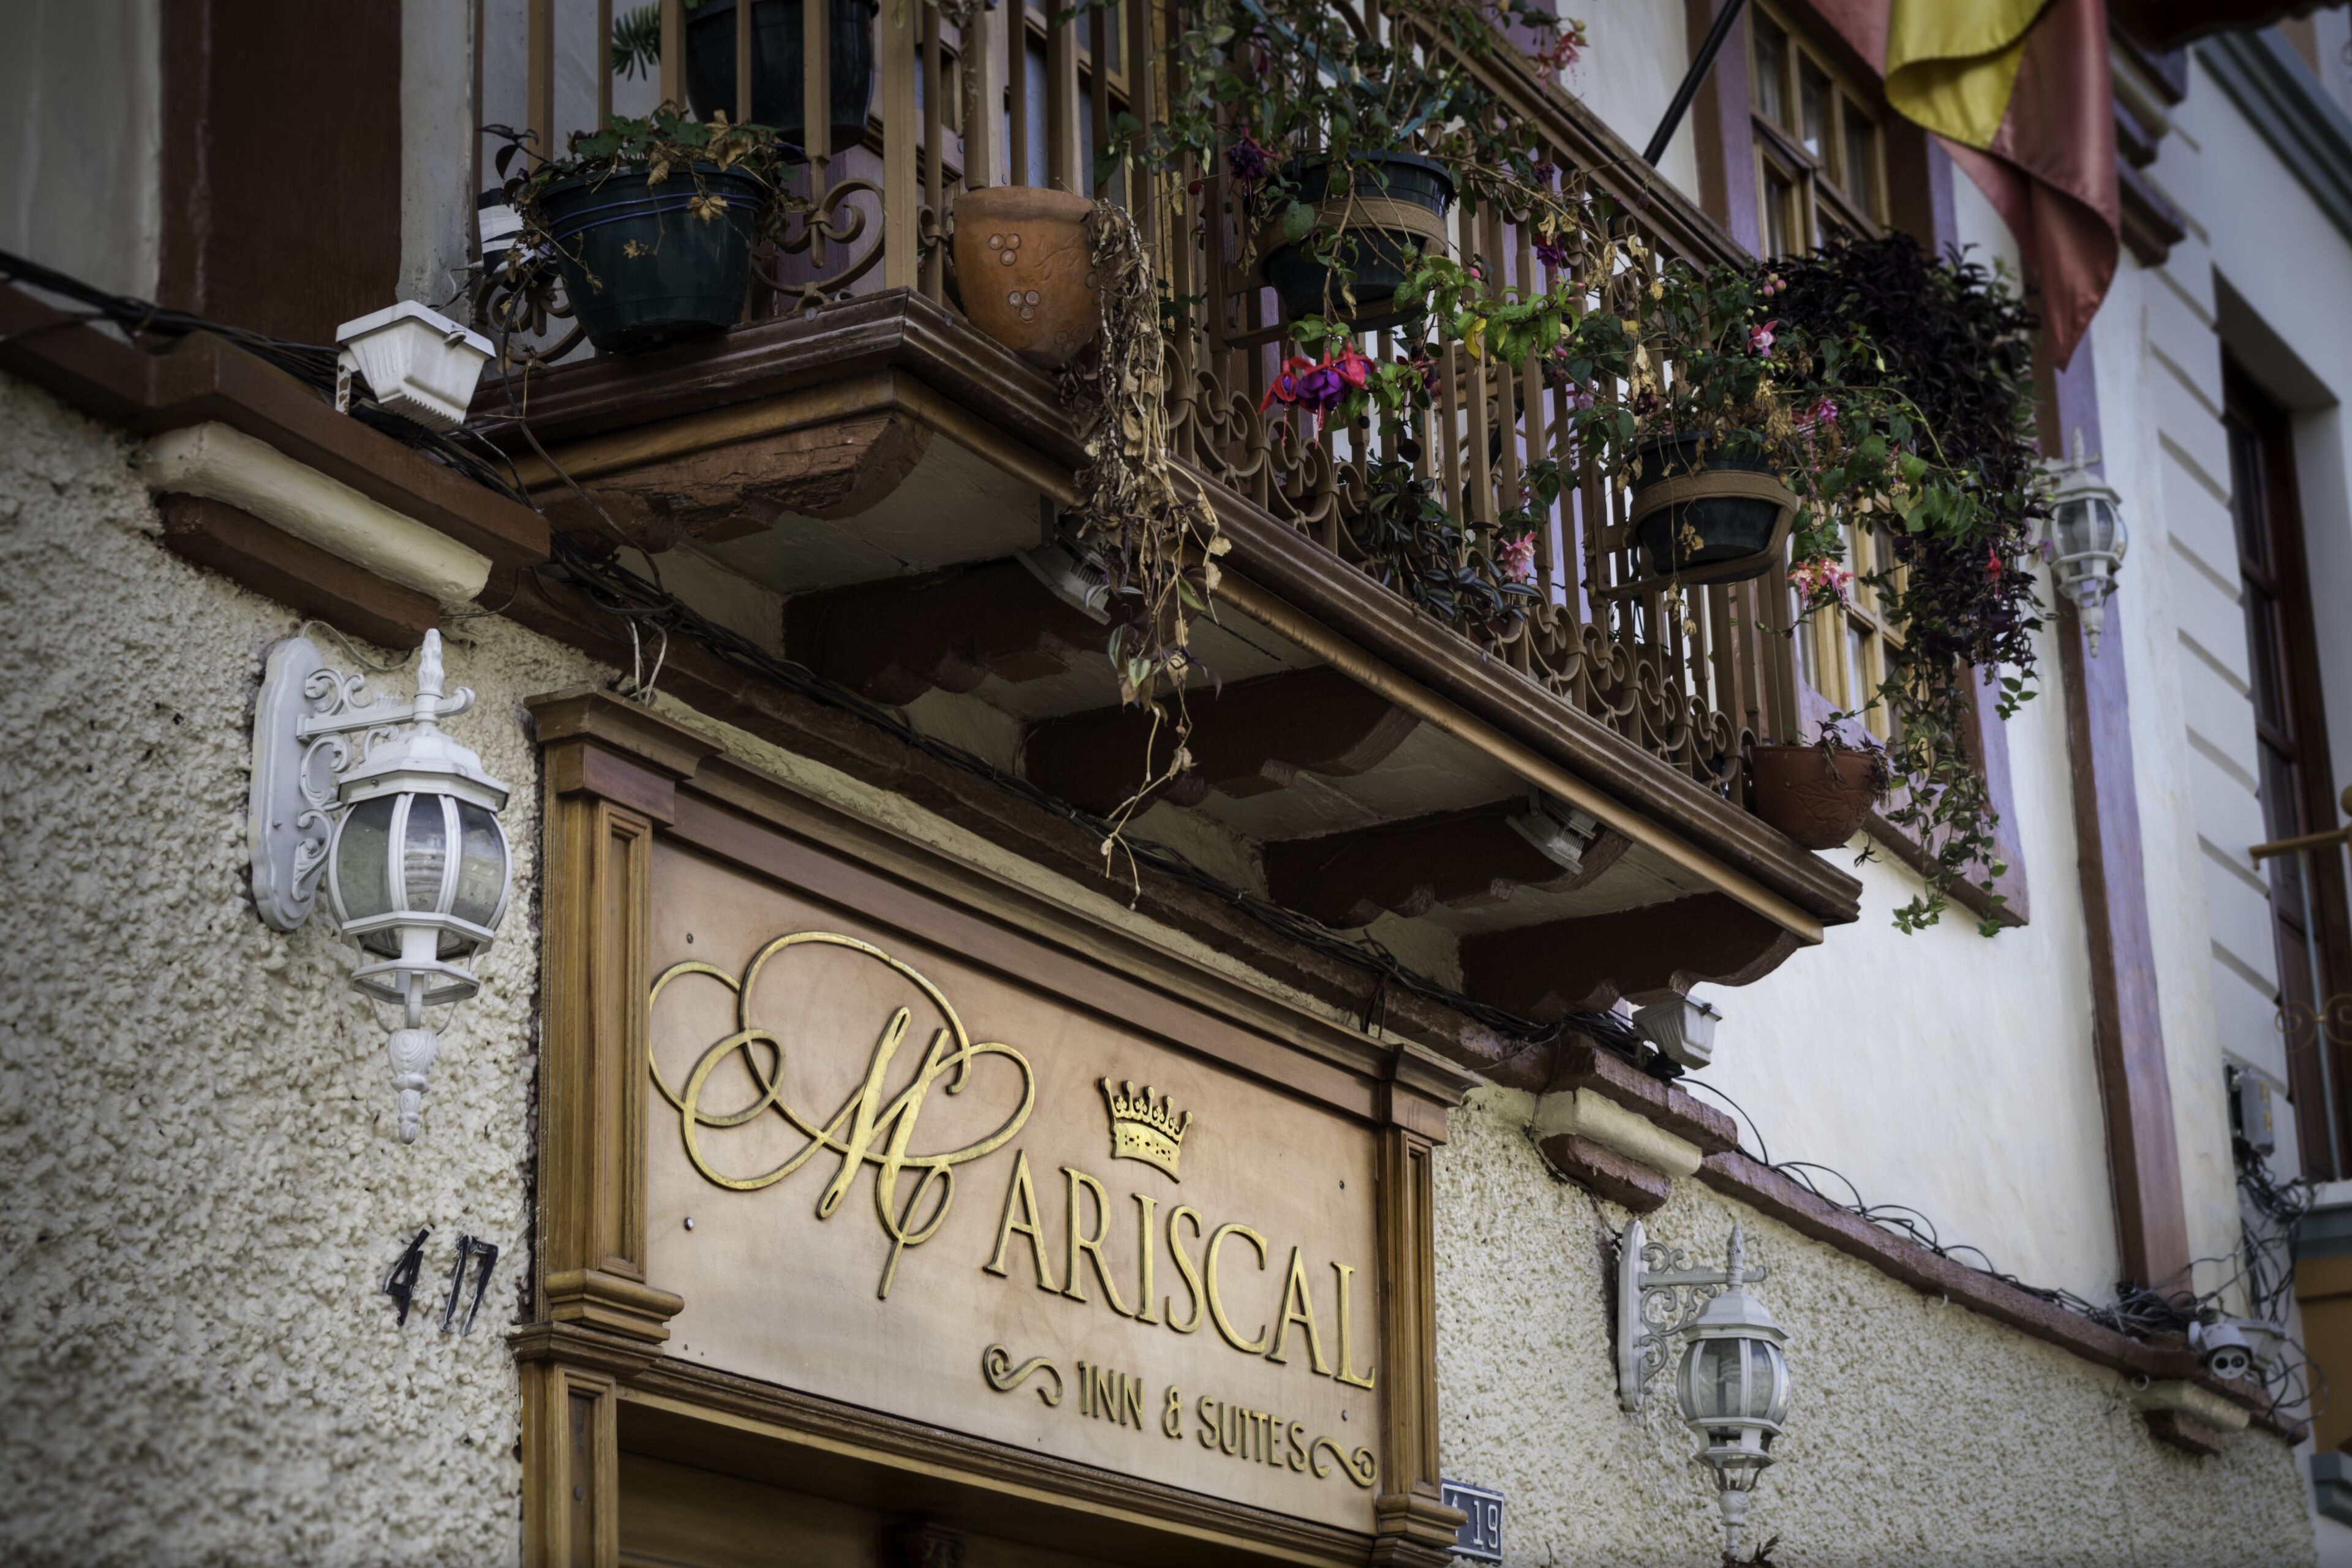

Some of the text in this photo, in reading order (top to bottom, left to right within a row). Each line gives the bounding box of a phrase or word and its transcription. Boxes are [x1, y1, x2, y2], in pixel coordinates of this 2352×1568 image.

[385, 1228, 499, 1337] 417
[1078, 1360, 1310, 1472] INN & SUITES
